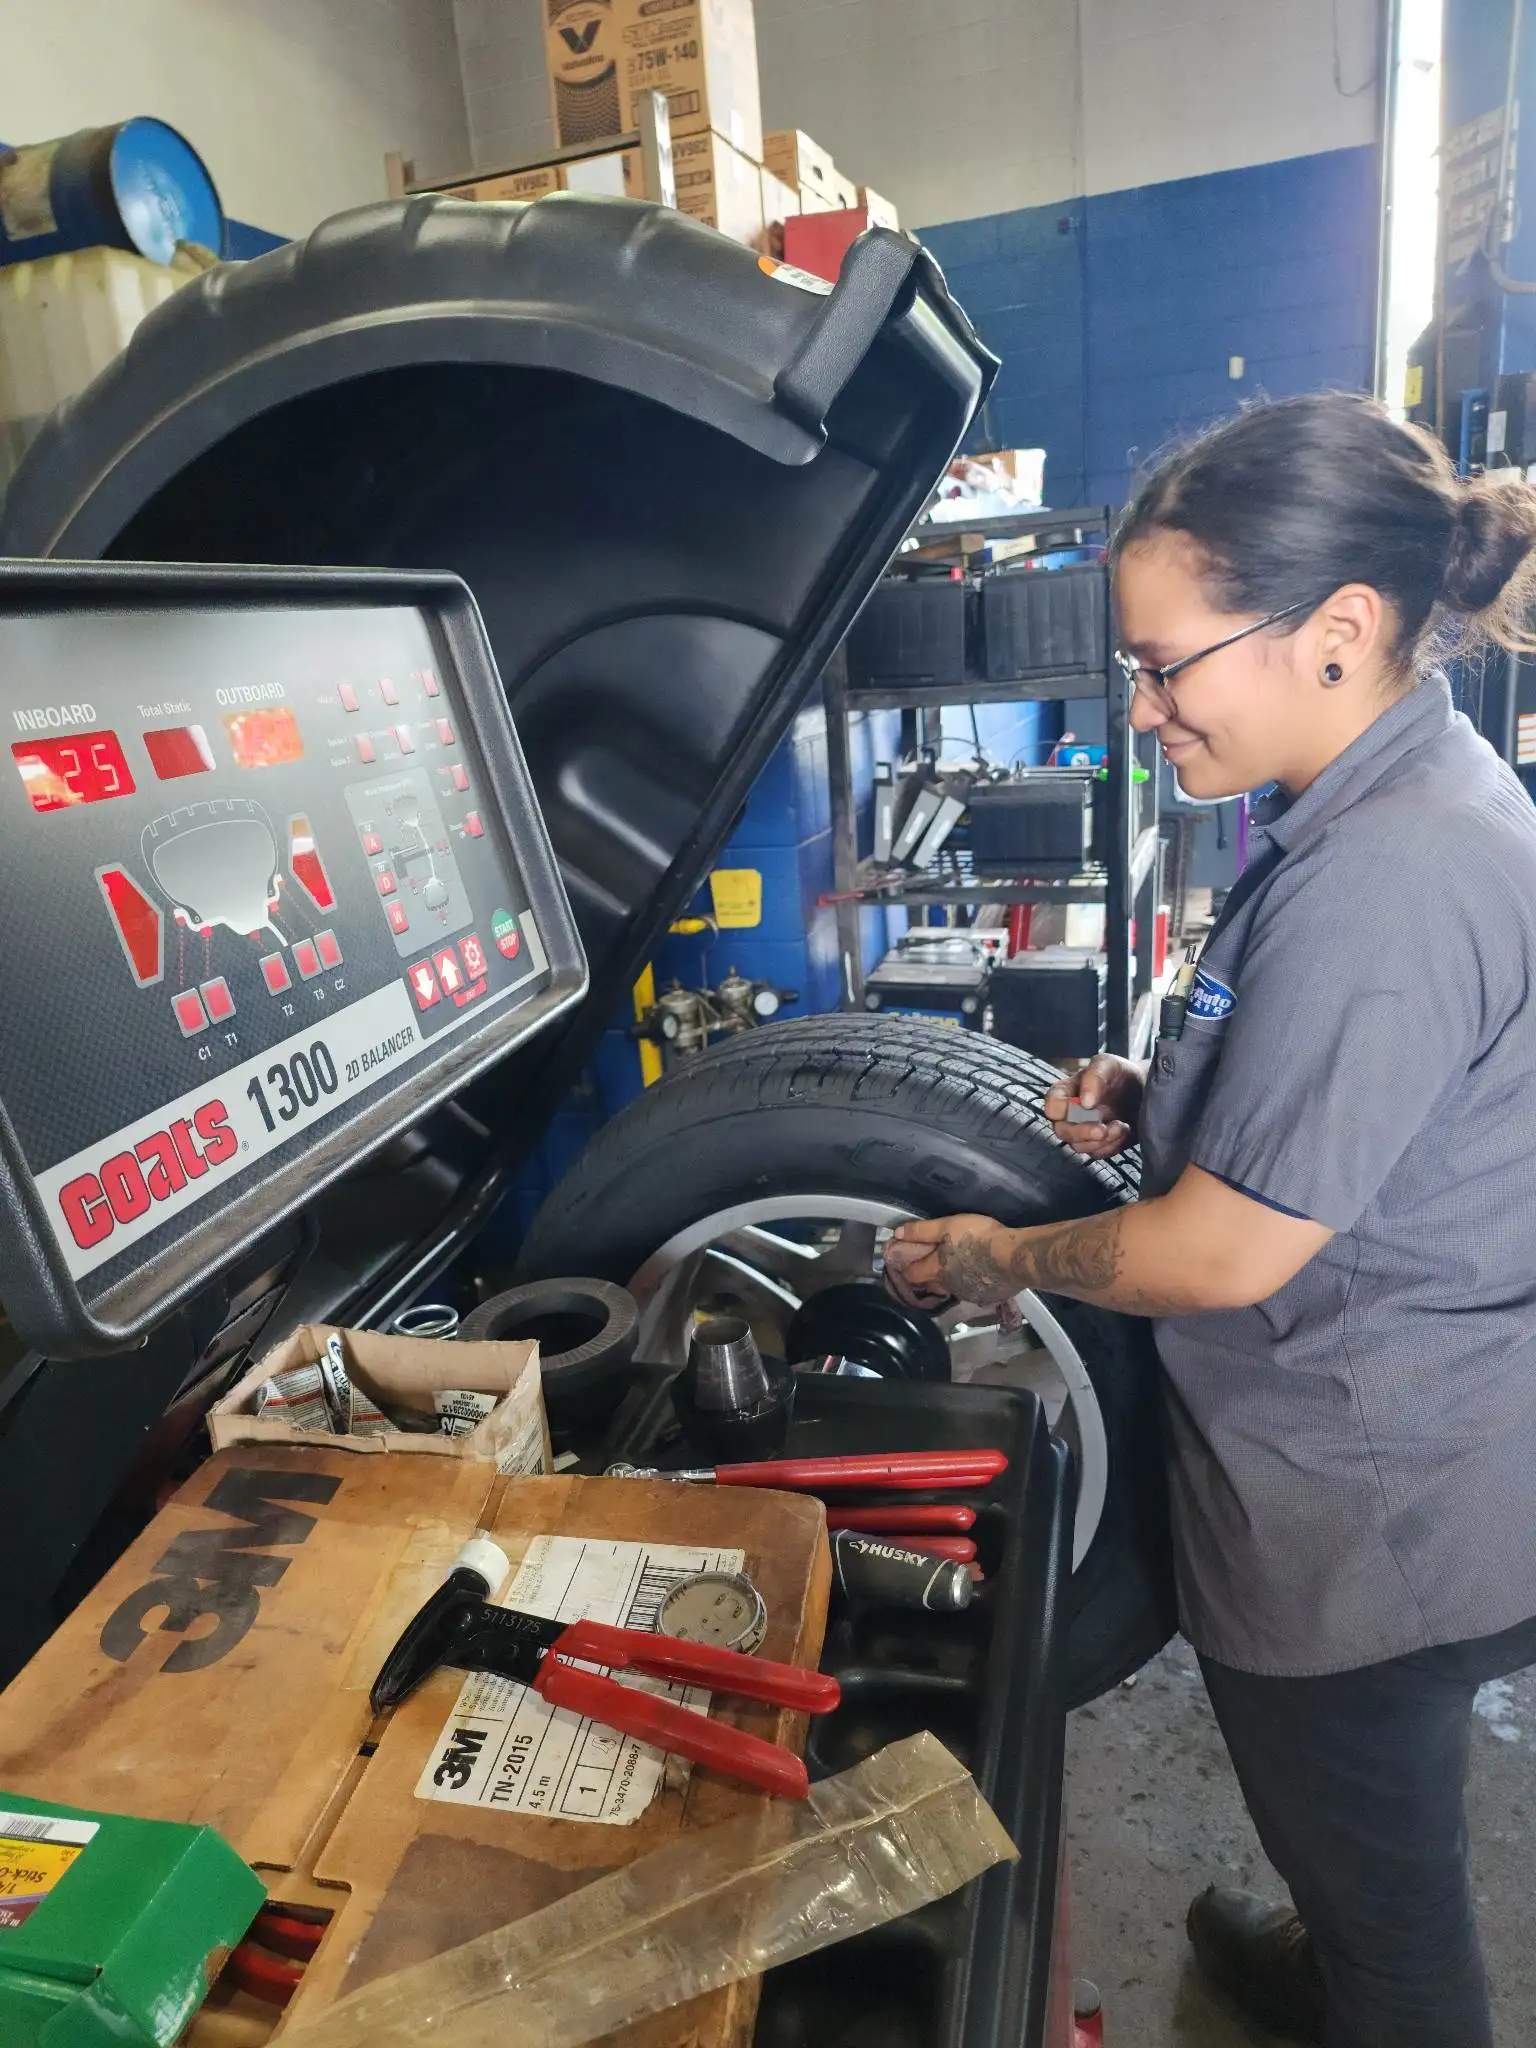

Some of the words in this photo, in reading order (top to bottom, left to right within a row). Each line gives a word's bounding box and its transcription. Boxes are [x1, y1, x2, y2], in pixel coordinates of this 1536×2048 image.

[636, 40, 699, 71] 75W-140
[216, 682, 286, 706] OUTBOARD
[13, 703, 97, 732] INBOARD
[137, 702, 162, 719] Total
[163, 699, 191, 716] Static
[382, 876, 391, 889] D
[494, 919, 515, 937] START
[500, 933, 517, 951] STOP
[313, 988, 325, 1001] T3
[334, 978, 346, 991] C2
[282, 1003, 295, 1017] T2
[225, 1032, 238, 1047] T1
[198, 1045, 212, 1061] C1
[247, 1040, 339, 1132] 1300
[345, 1059, 360, 1083] 2D
[361, 1026, 415, 1072] BALANCER
[868, 1543, 929, 1567] HUSKY
[100, 1467, 344, 1673] 3M
[433, 1728, 488, 1790] 3M
[490, 1734, 533, 1802] TN-2015
[540, 1776, 551, 1787] m
[609, 1743, 641, 1817] 75-3470-2088-7
